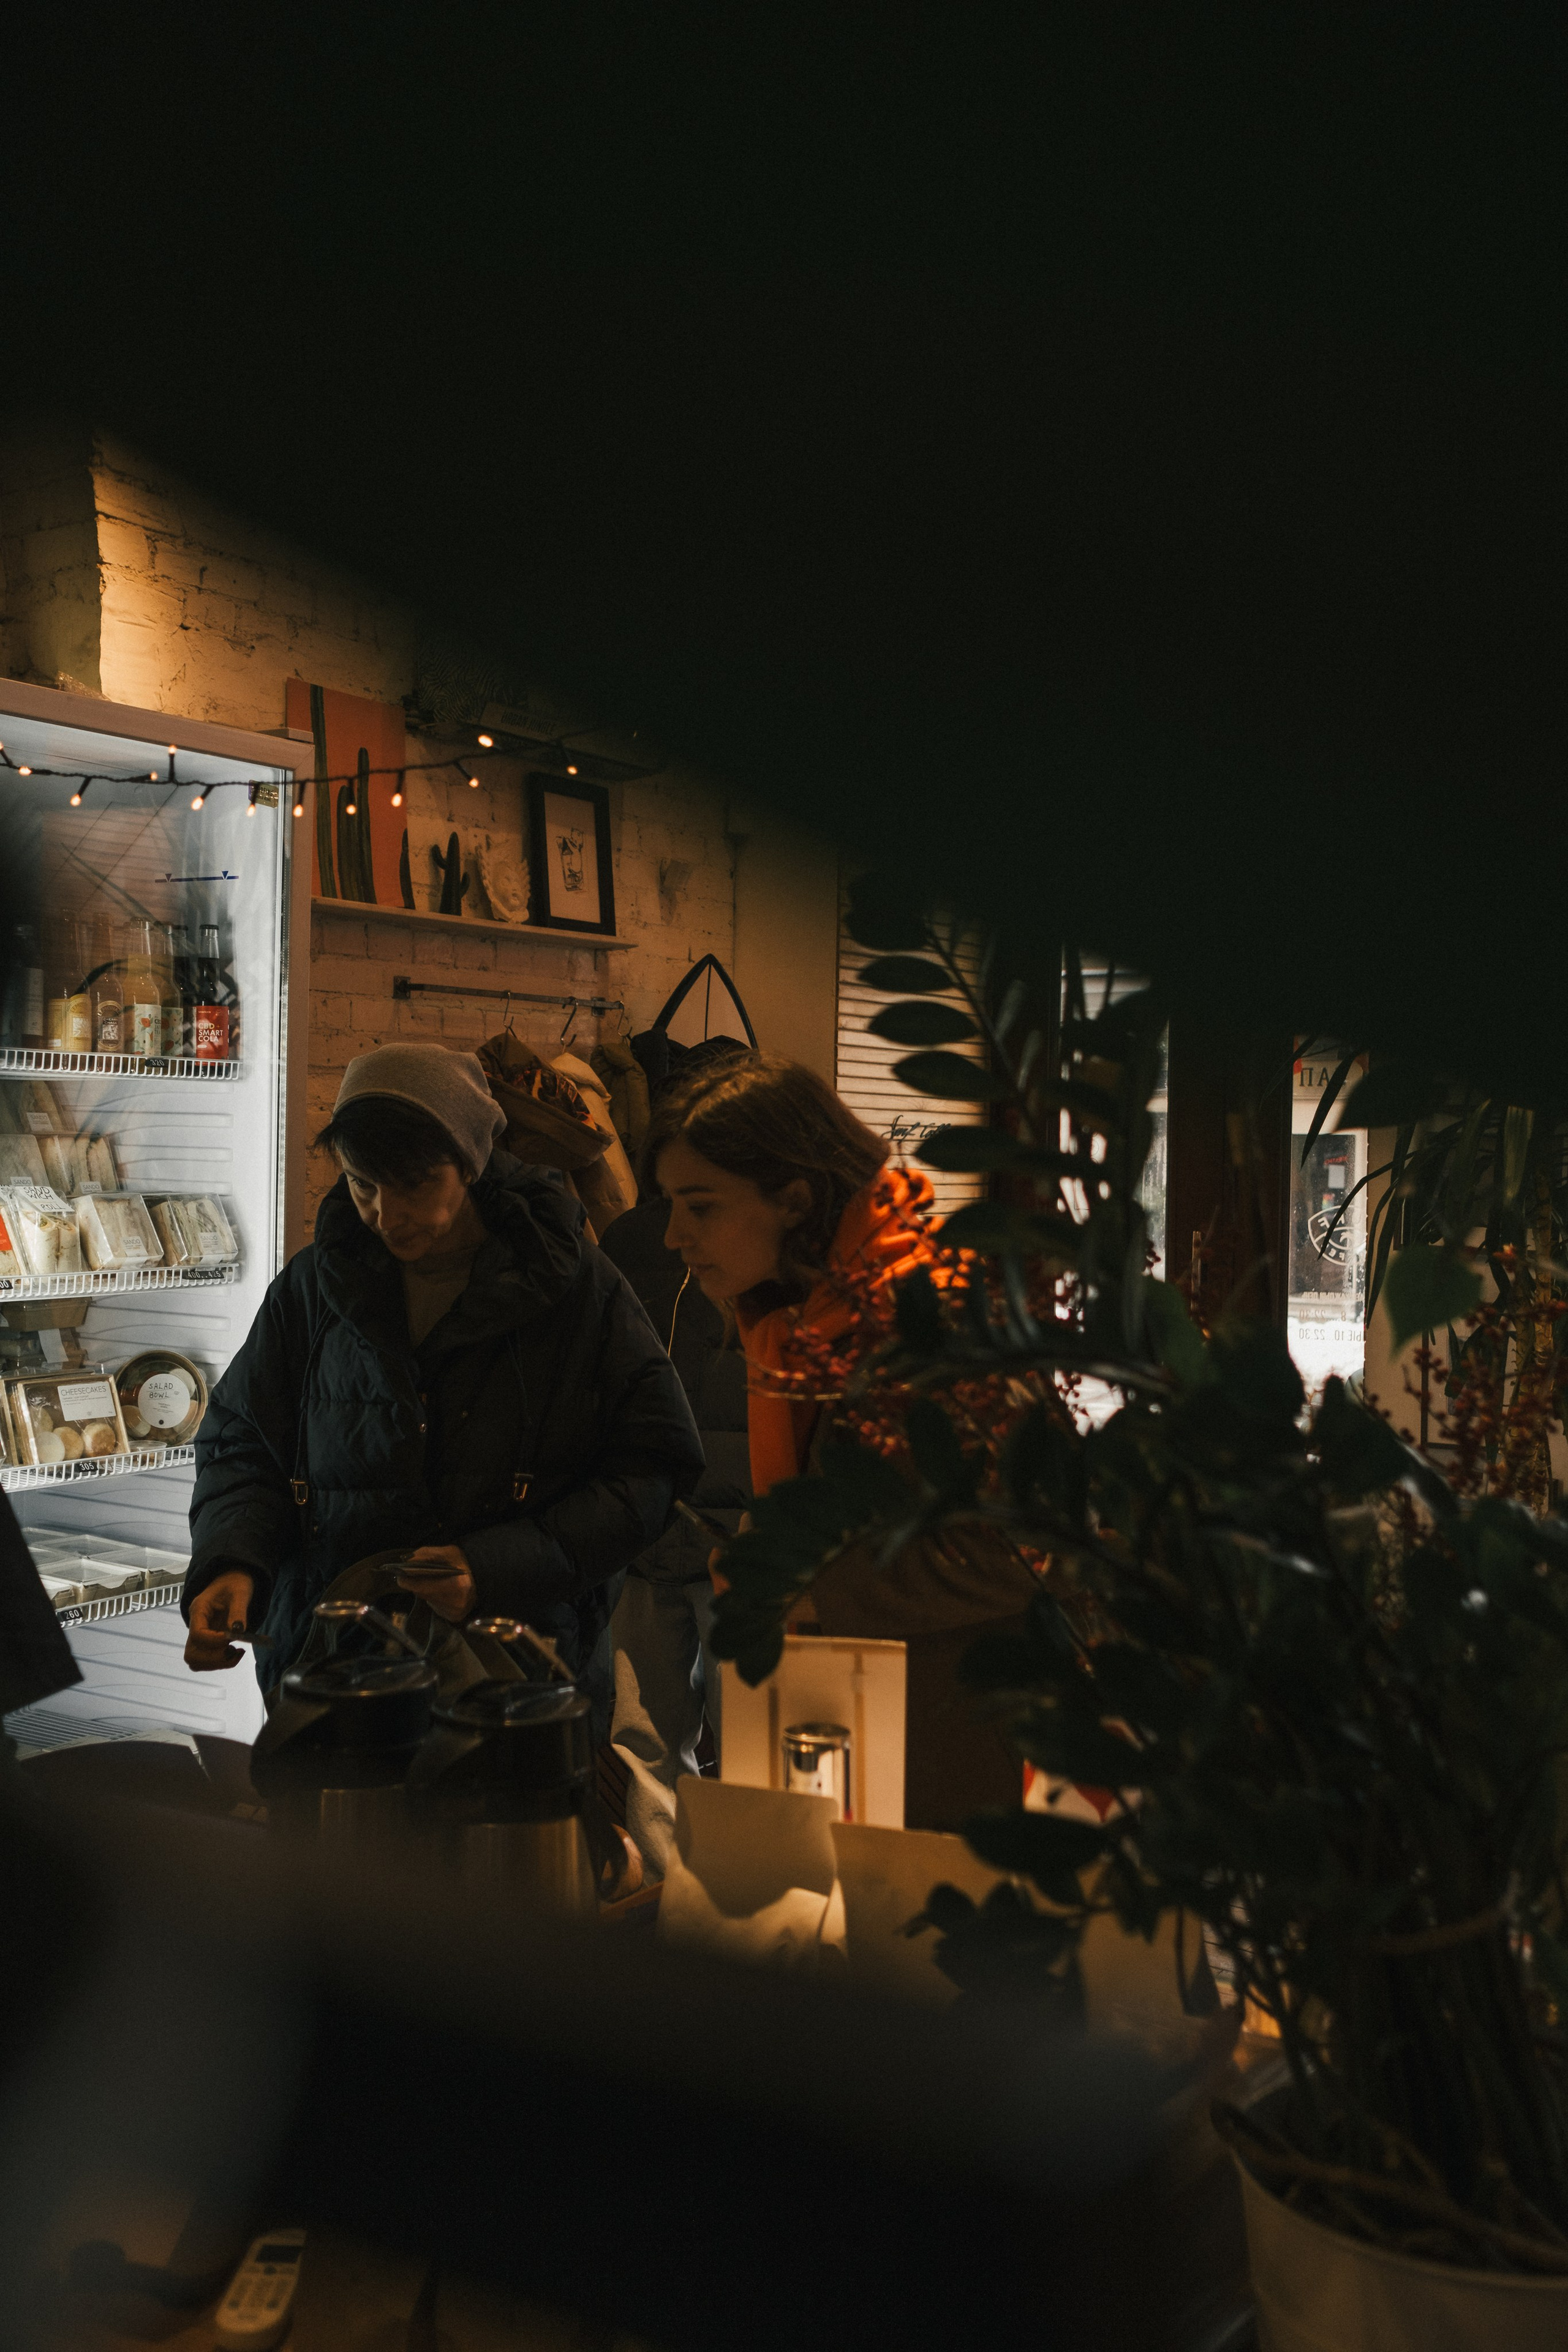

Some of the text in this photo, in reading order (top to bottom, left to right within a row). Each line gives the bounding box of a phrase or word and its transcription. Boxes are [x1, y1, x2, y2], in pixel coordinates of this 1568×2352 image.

[500, 709, 529, 729] URBAN
[61, 1385, 107, 1396] CHEESECAKES
[64, 1609, 80, 1619] 260
